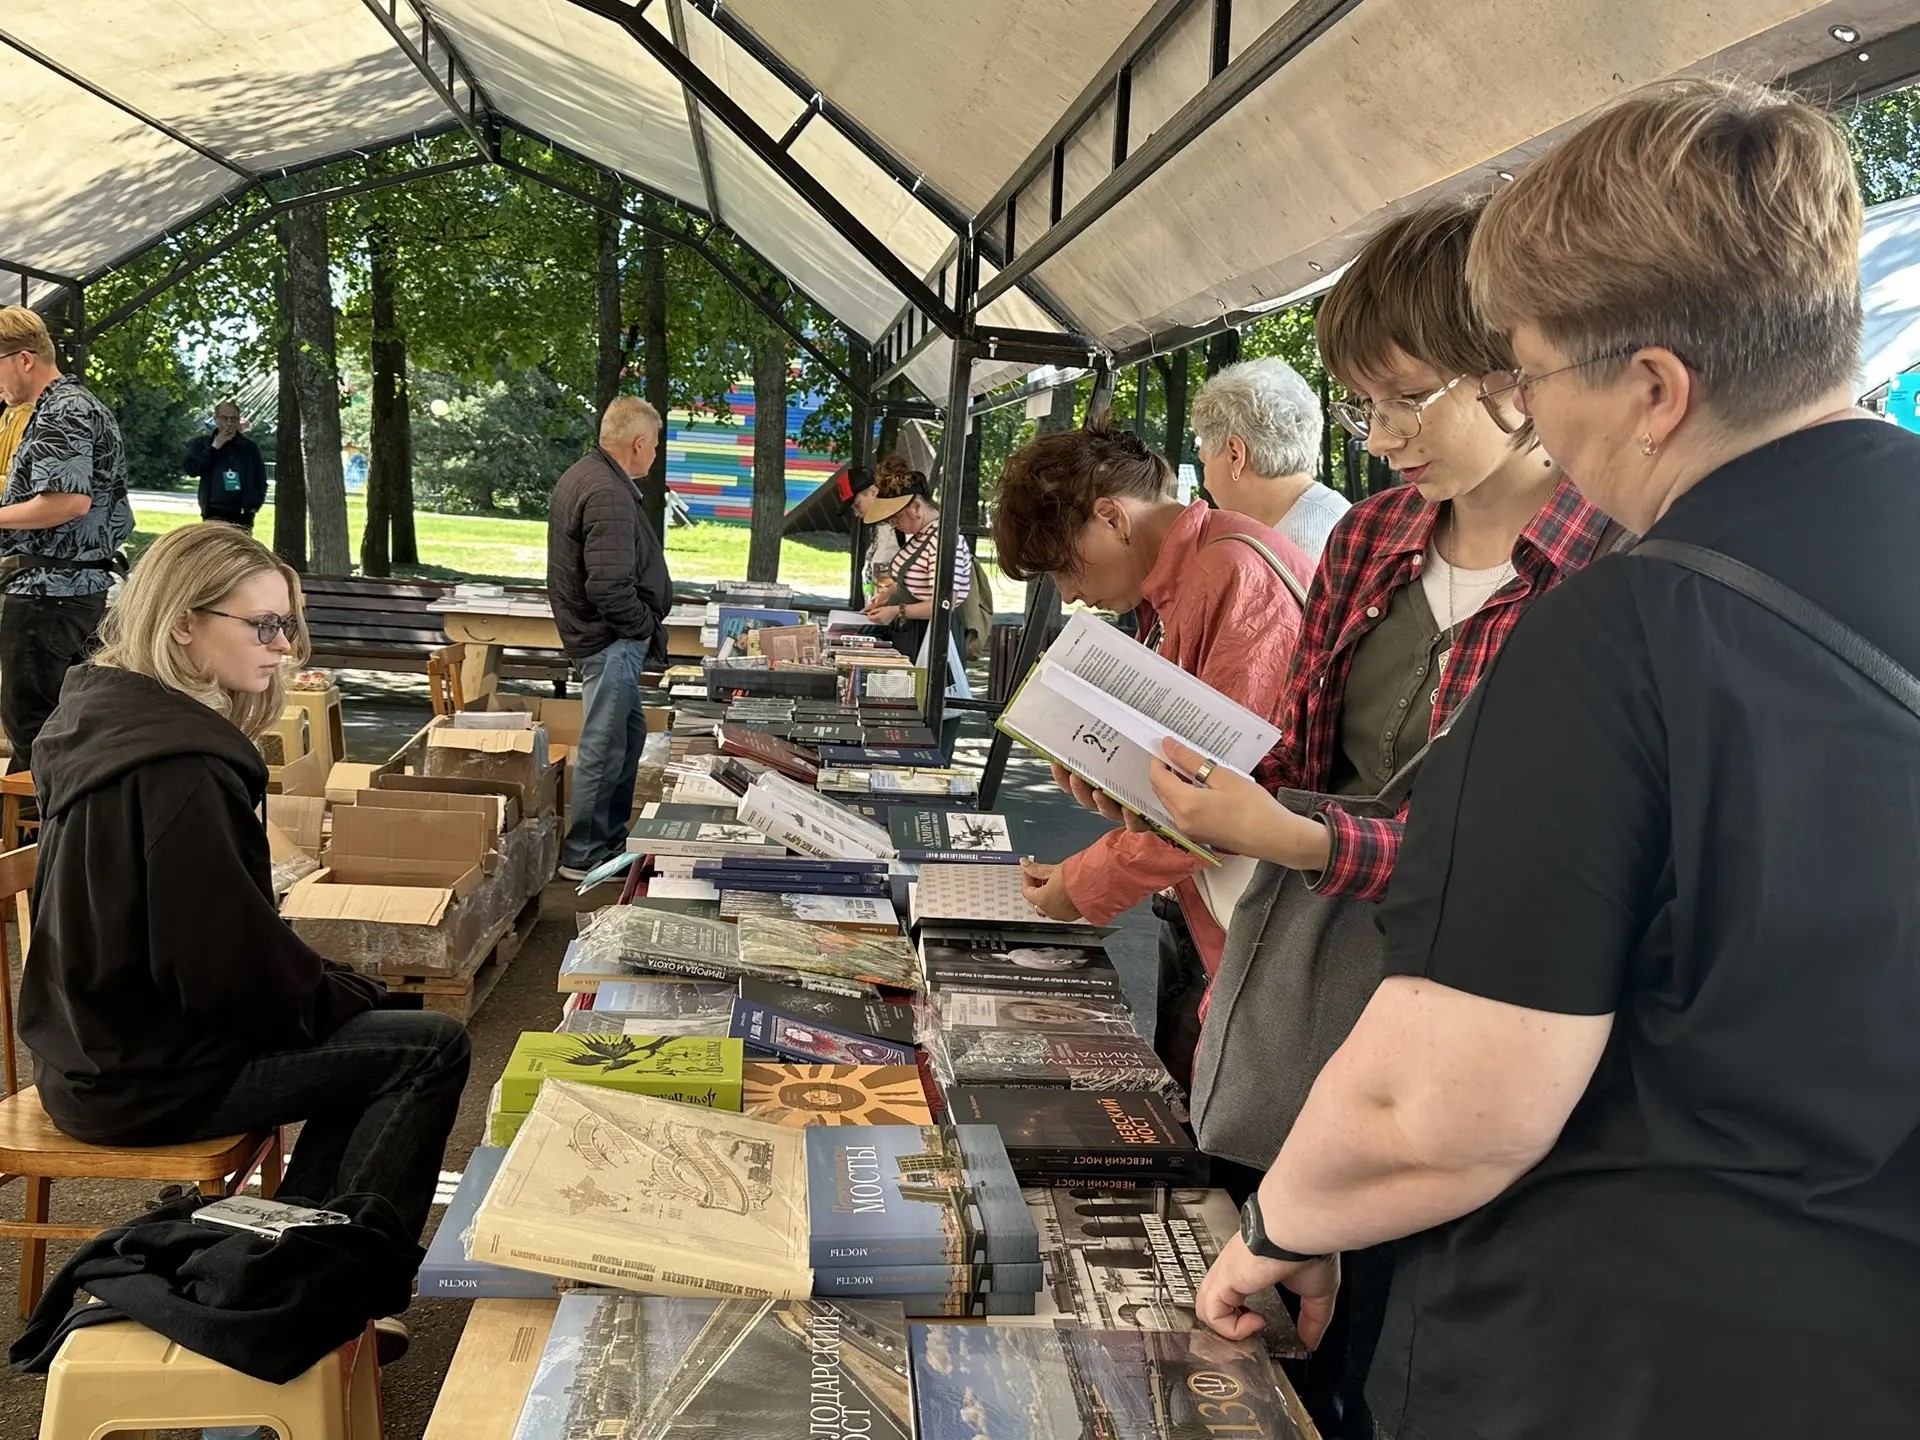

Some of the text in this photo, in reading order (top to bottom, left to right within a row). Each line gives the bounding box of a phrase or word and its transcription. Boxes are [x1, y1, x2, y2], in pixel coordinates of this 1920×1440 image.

[648, 959, 726, 979] ПРИРОДА И ОХОТА
[964, 1055, 1144, 1066] КОНСТРУКТОРЫ
[1097, 1098, 1141, 1142] НЕВСКИЙ
[1128, 1116, 1160, 1143] МОСТ
[1073, 1156, 1102, 1164] МОСТ
[1105, 1156, 1153, 1166] НЕВСКИЙ
[846, 1145, 885, 1213] МОСТЫ
[1055, 1179, 1084, 1187] МОСТ
[1087, 1180, 1135, 1190] НЕВСКИЙ
[1168, 1220, 1200, 1252] МОСТОВ
[830, 1248, 868, 1257] МОСТЫ
[439, 1279, 477, 1287] МОСТЫ
[836, 1276, 873, 1285] МОСТЫ
[1160, 1264, 1194, 1303] ИСТОРИЯ
[806, 1313, 844, 1440] ЛОДАРСКИЙ
